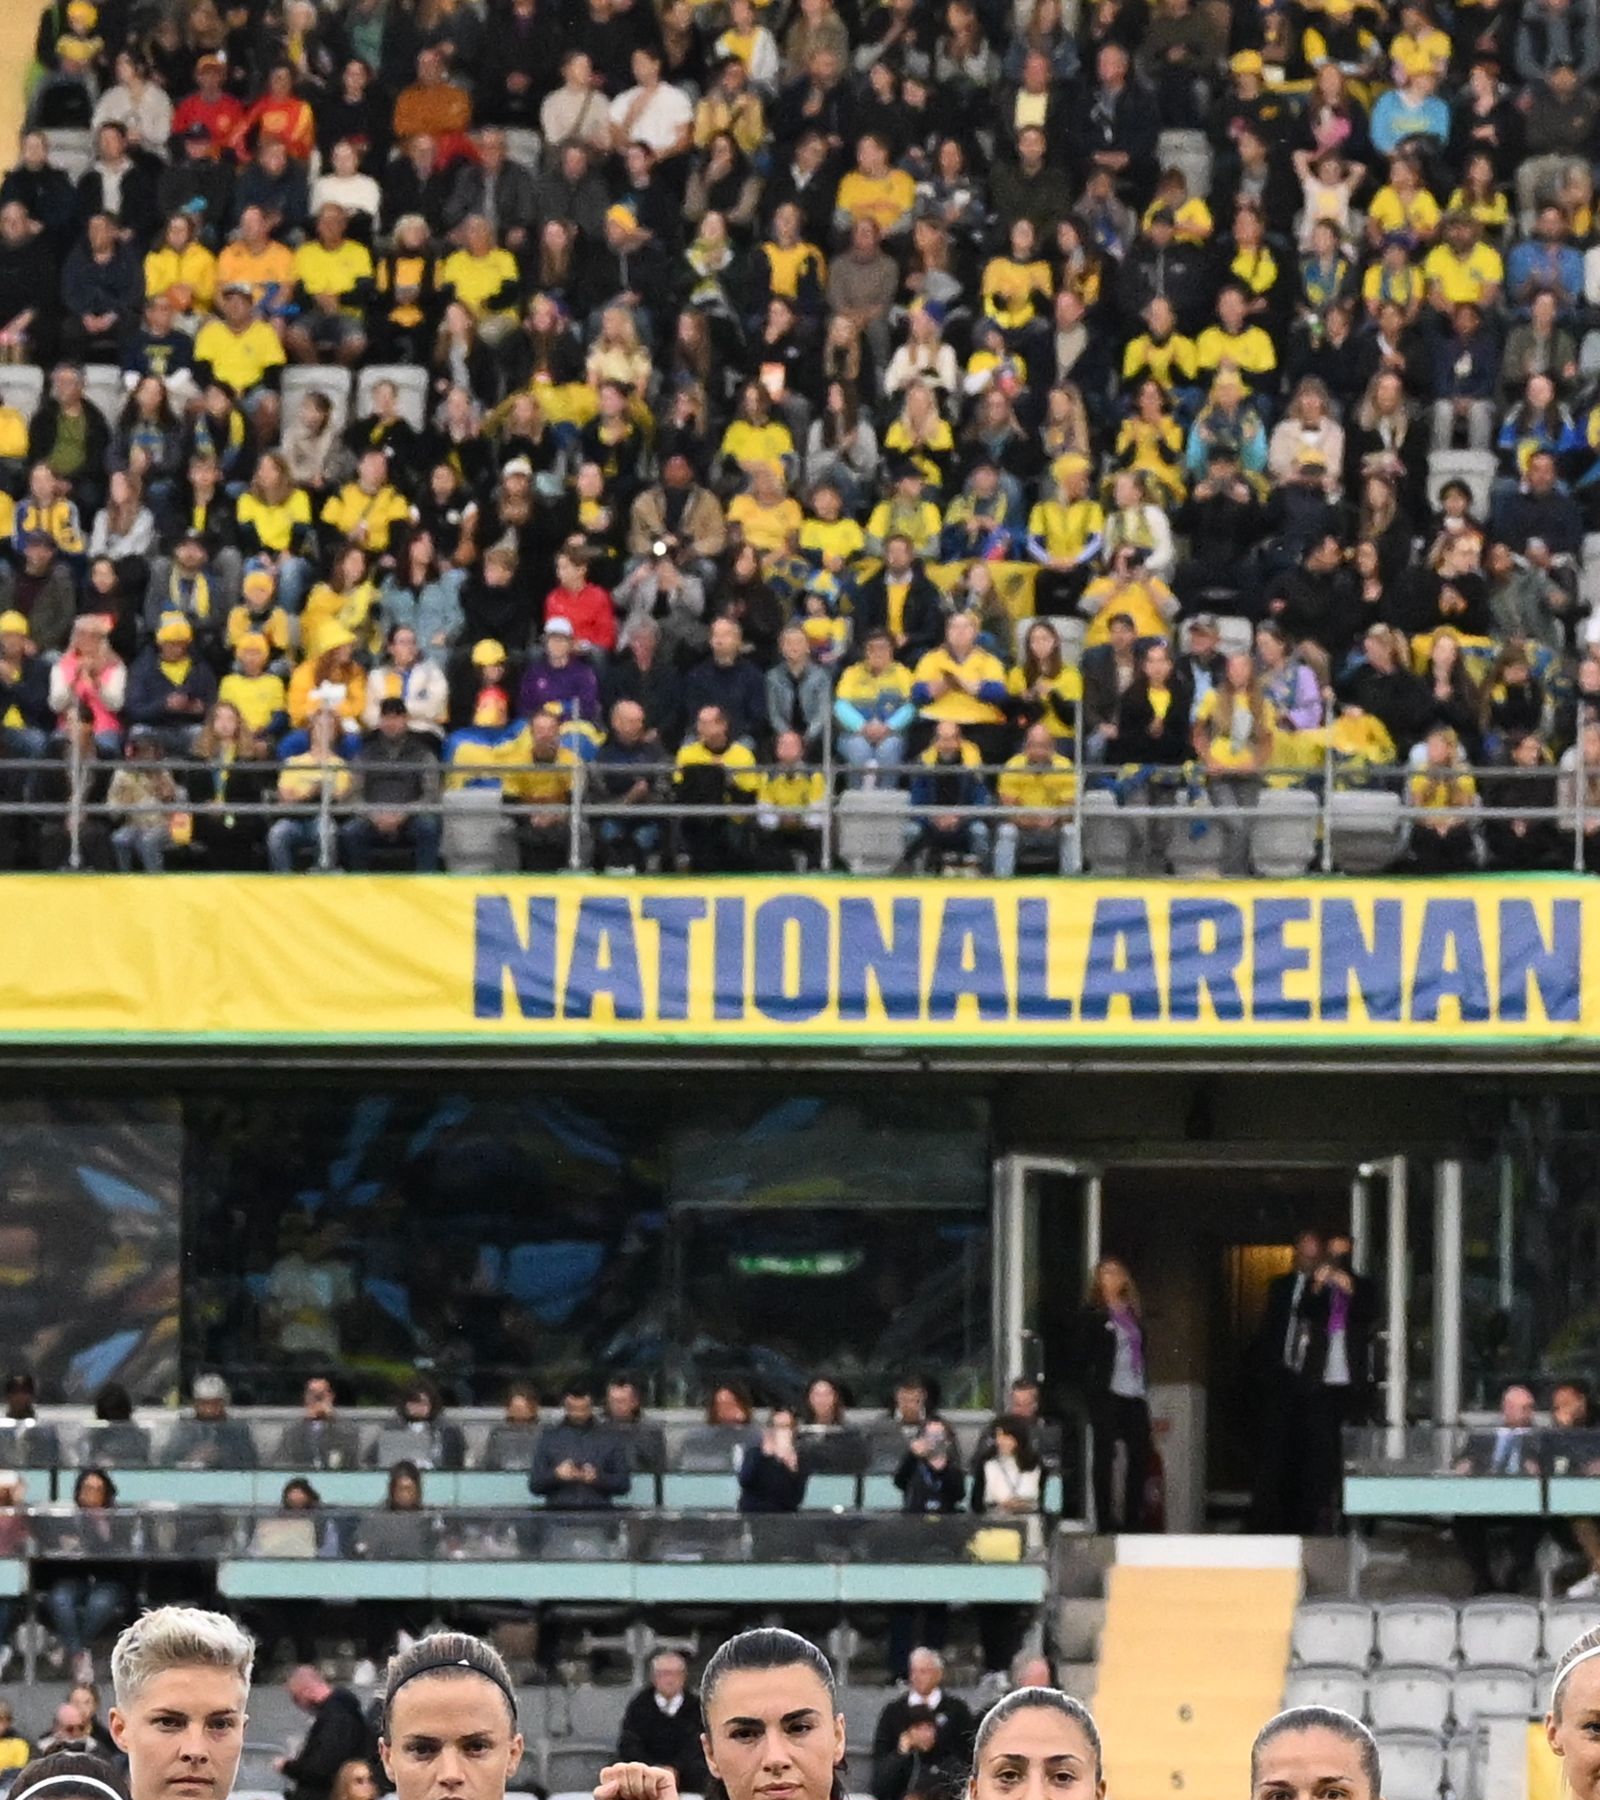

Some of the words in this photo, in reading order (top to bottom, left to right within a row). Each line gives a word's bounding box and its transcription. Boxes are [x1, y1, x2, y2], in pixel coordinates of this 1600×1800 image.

[475, 896, 1581, 1022] NATIONALARENAN
[1178, 1703, 1193, 1722] 6
[1170, 1770, 1185, 1790] 5
